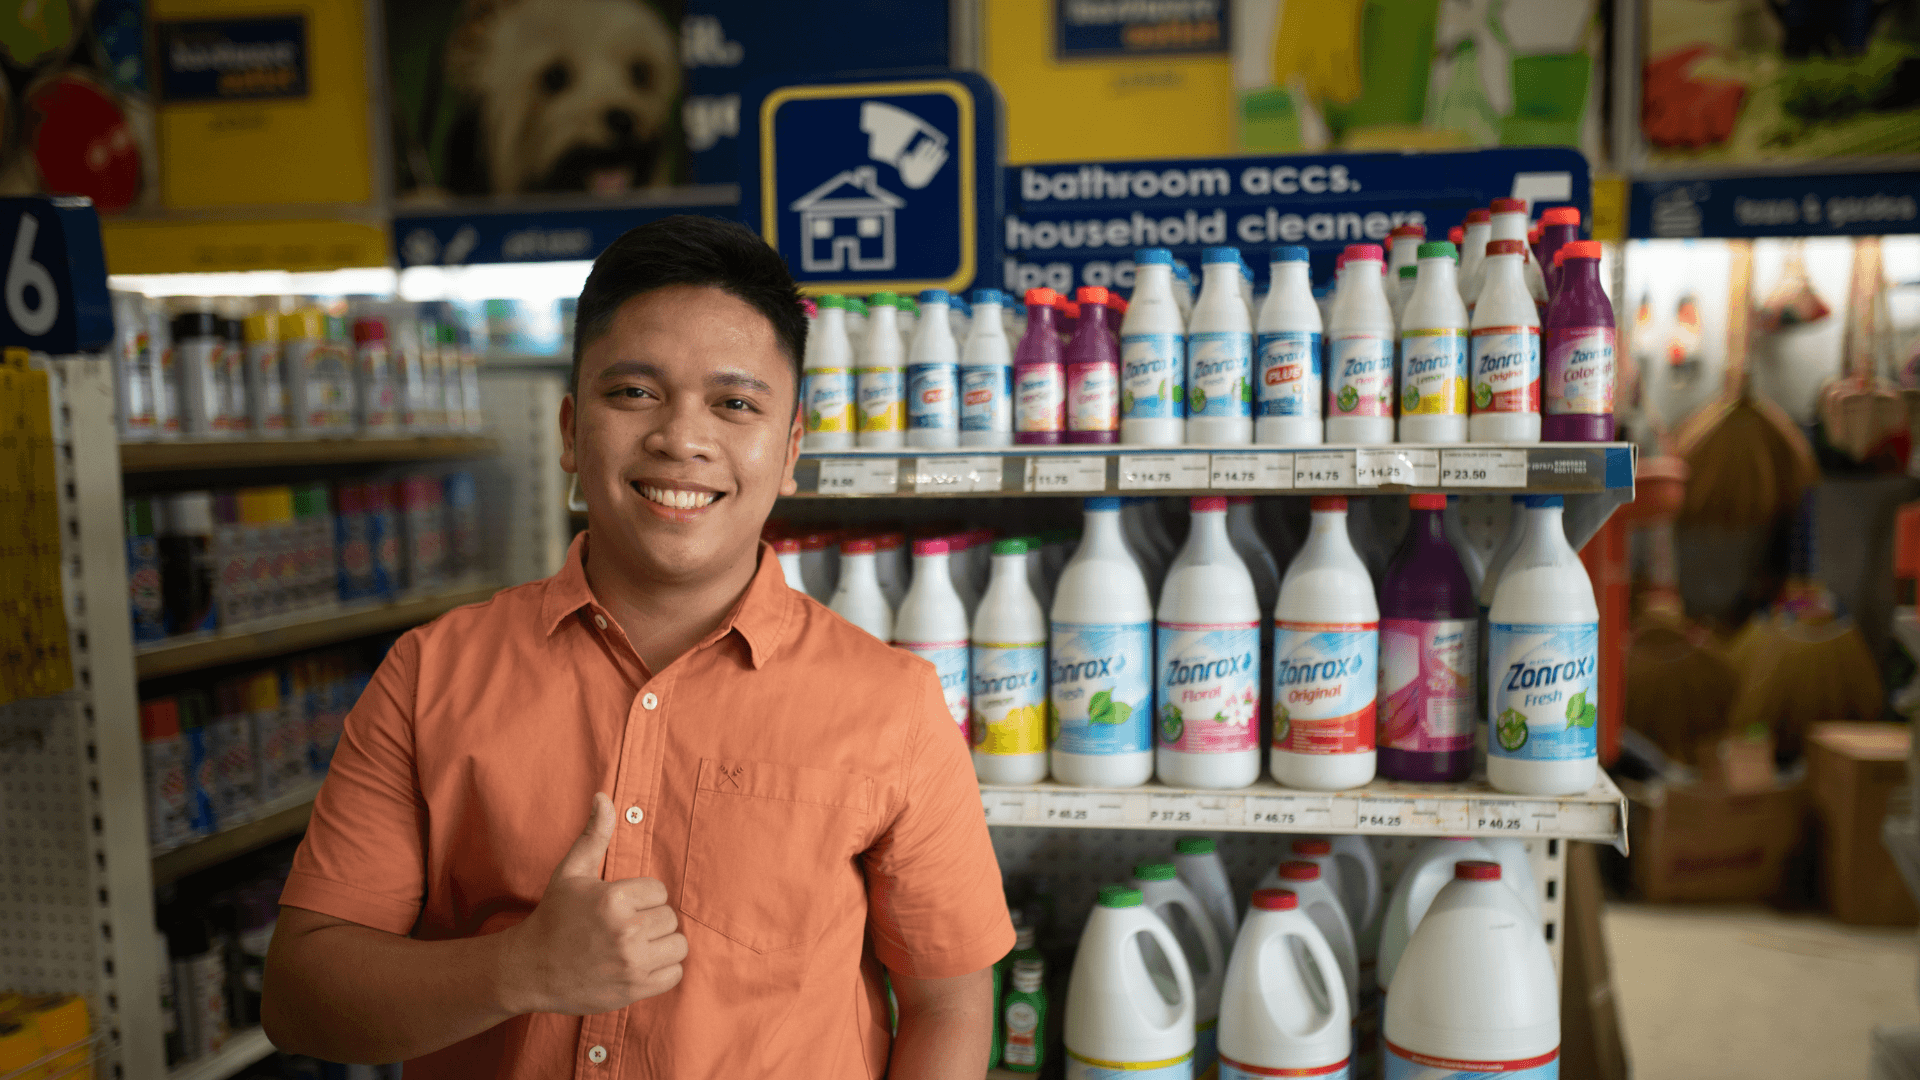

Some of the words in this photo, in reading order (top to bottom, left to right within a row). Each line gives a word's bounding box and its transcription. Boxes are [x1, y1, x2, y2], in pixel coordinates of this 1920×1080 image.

[1021, 166, 1231, 200] bathroom
[1240, 165, 1361, 195] accs.
[1006, 208, 1227, 249] household
[1237, 207, 1426, 243] cleaners
[6, 212, 58, 335] 6
[1124, 359, 1171, 381] Zonro
[1194, 359, 1241, 380] Zonro
[1407, 353, 1455, 377] Zonro
[1479, 351, 1530, 375] Zonro
[1268, 366, 1302, 383] PLUS
[1489, 368, 1527, 384] Origina
[1141, 472, 1171, 482] 14.75
[1213, 472, 1221, 481] P
[1225, 472, 1255, 481] 14.75
[1297, 471, 1304, 481] P
[1308, 471, 1339, 481] 14.75
[1443, 470, 1451, 479] P
[1454, 469, 1486, 479] 23.50
[1166, 655, 1241, 686] Zonrox
[1278, 657, 1350, 687] Zonrox
[1507, 657, 1587, 692] Zonrox
[1181, 685, 1222, 703] Floral
[1288, 684, 1342, 705] Original
[1524, 690, 1562, 707] Fresh
[1150, 811, 1158, 821] P
[1254, 812, 1261, 822] P
[1360, 815, 1367, 824] P
[1478, 819, 1486, 829] P
[1490, 819, 1520, 829] 40.25
